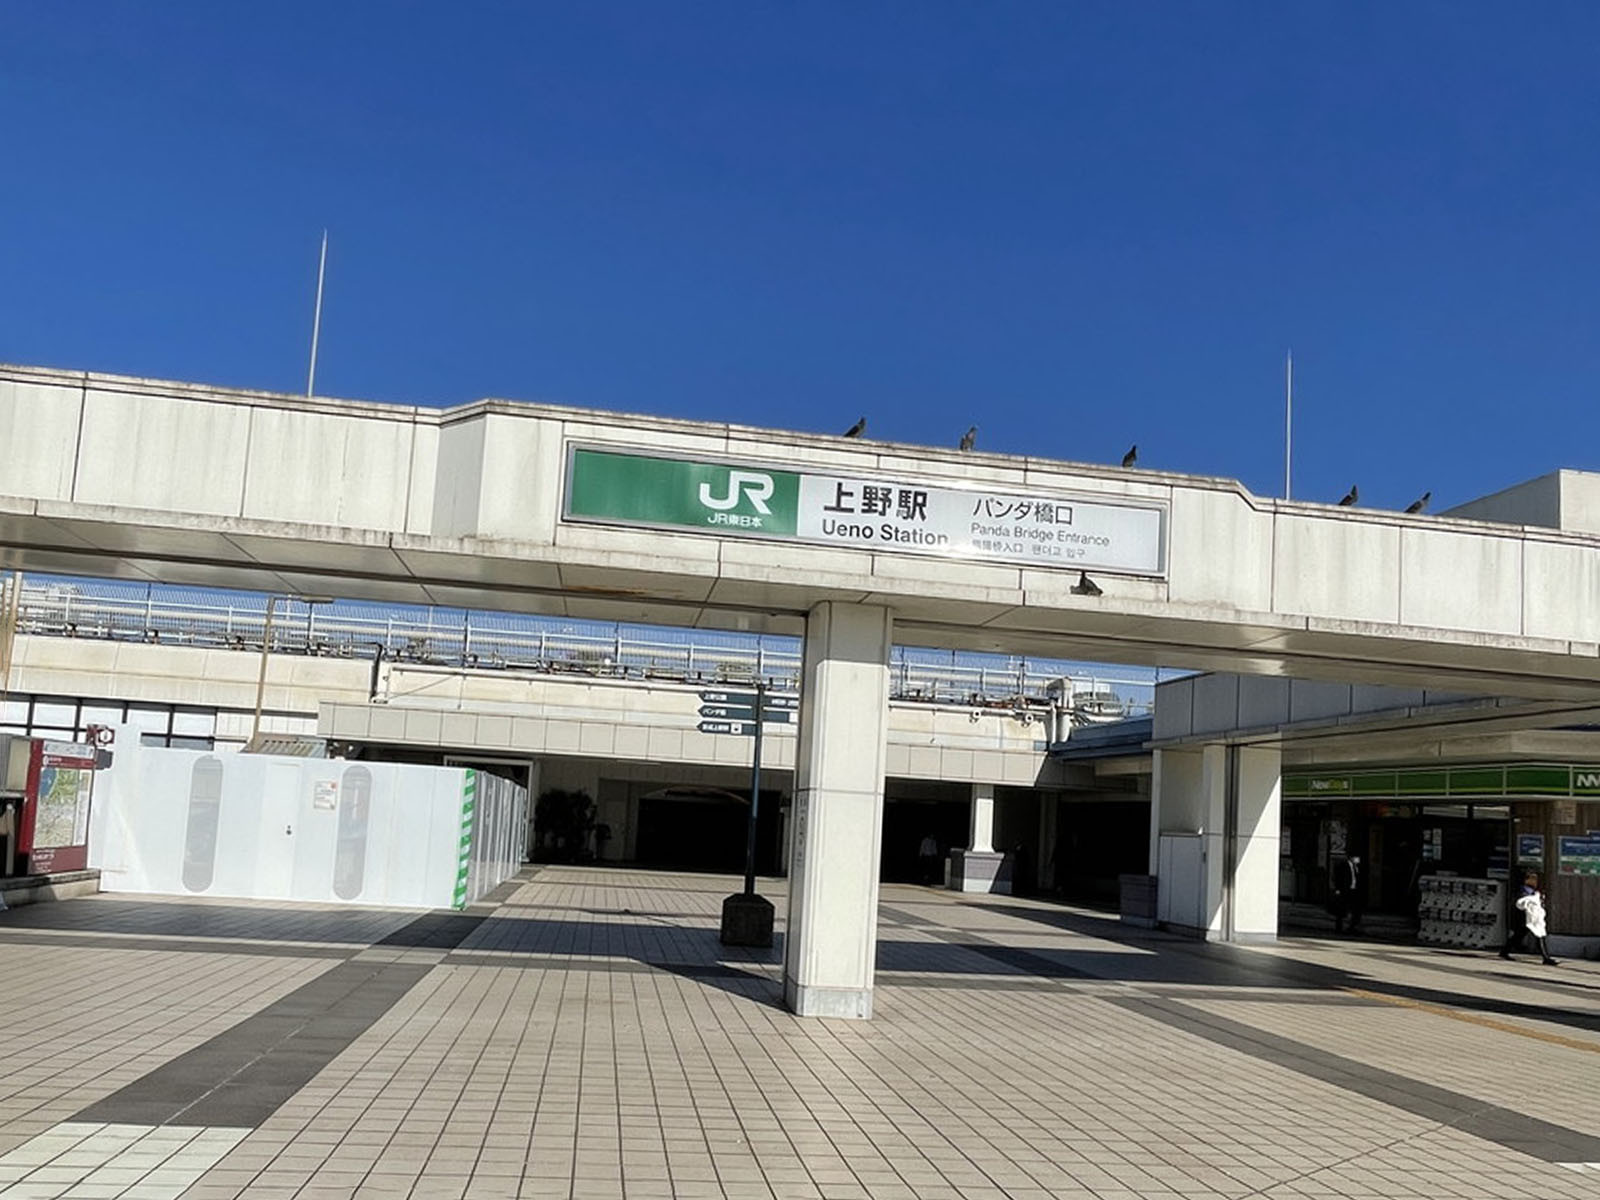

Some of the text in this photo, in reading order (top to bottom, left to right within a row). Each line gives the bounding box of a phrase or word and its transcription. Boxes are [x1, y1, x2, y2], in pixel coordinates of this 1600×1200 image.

[699, 470, 774, 515] JR
[823, 482, 928, 521] 上野駅
[707, 512, 763, 528] JR東日本
[972, 498, 1073, 525] パンダ橋口
[822, 519, 949, 545] Ueno Station
[970, 522, 1110, 547] Panda Bridge Entrance
